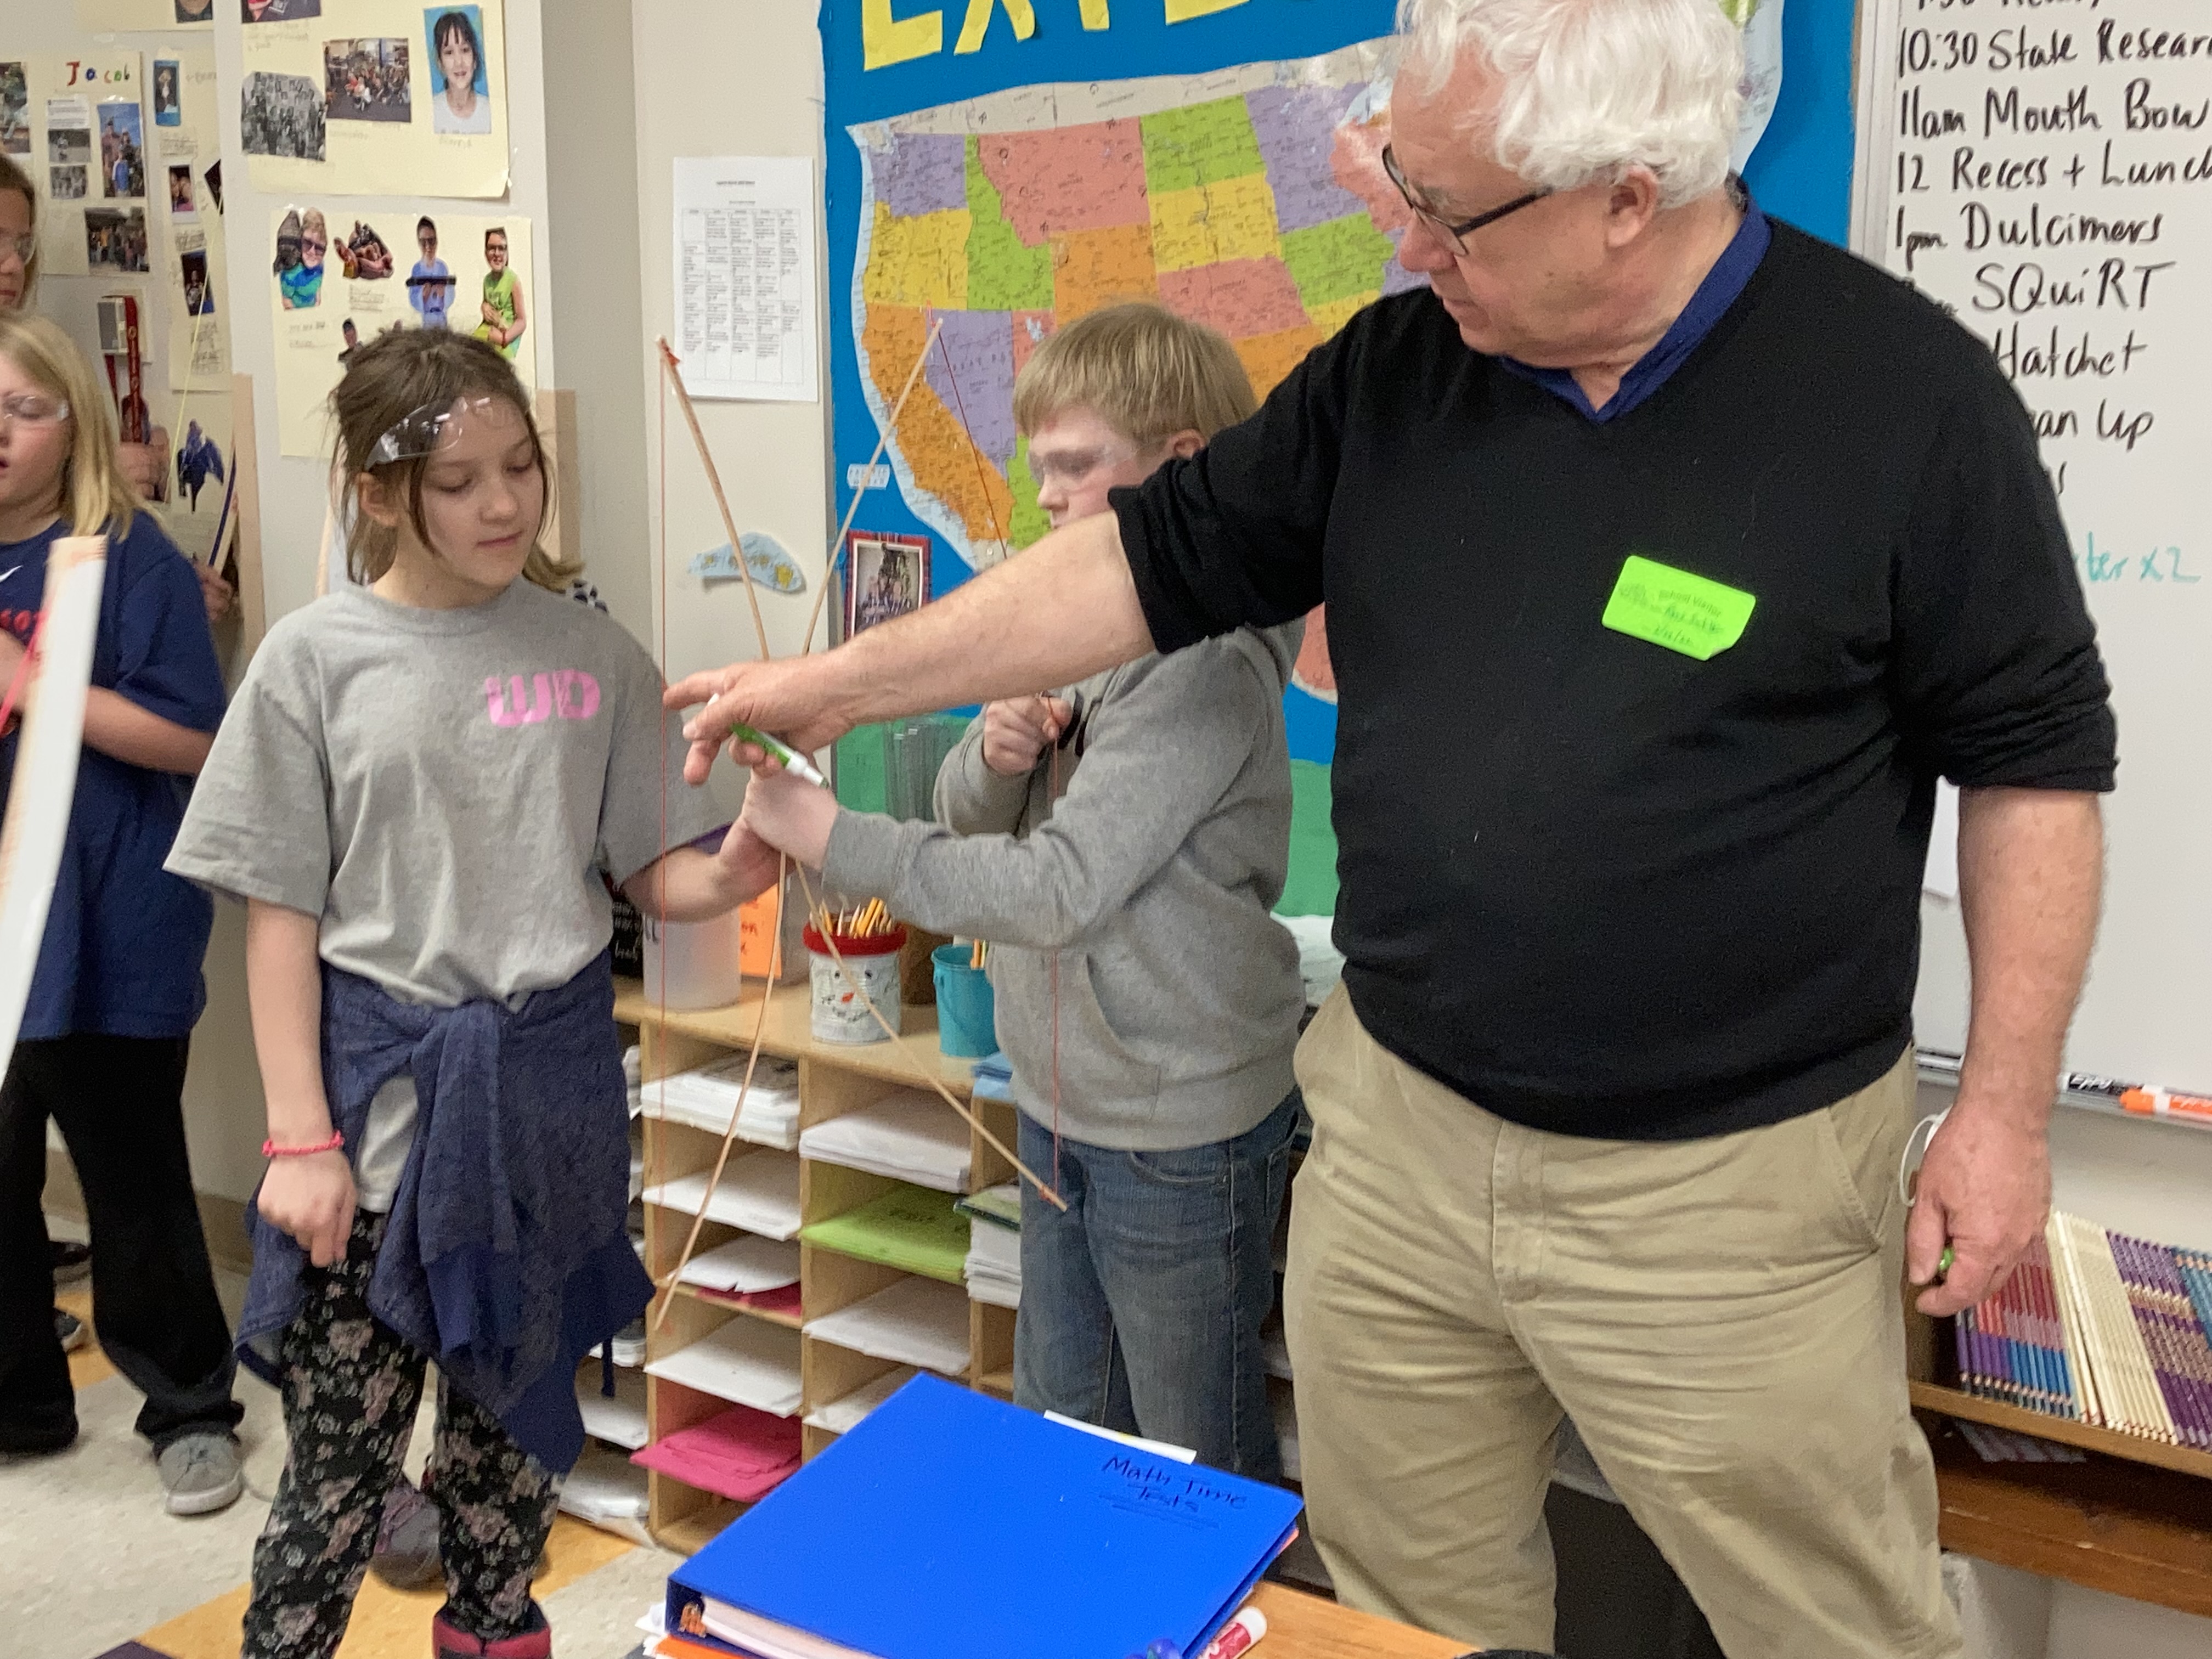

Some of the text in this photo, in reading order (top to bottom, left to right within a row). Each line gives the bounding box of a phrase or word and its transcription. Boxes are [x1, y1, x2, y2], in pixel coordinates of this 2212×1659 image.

[66, 61, 131, 87] Jacob
[1899, 26, 1978, 78] 10:30
[1900, 77, 2210, 139] 11am Mouth Bow
[1897, 151, 1931, 193] 12
[1951, 145, 2050, 190] Recess
[1896, 201, 2164, 272] 1pm Dulcimers
[1994, 321, 2148, 380] Hatchet
